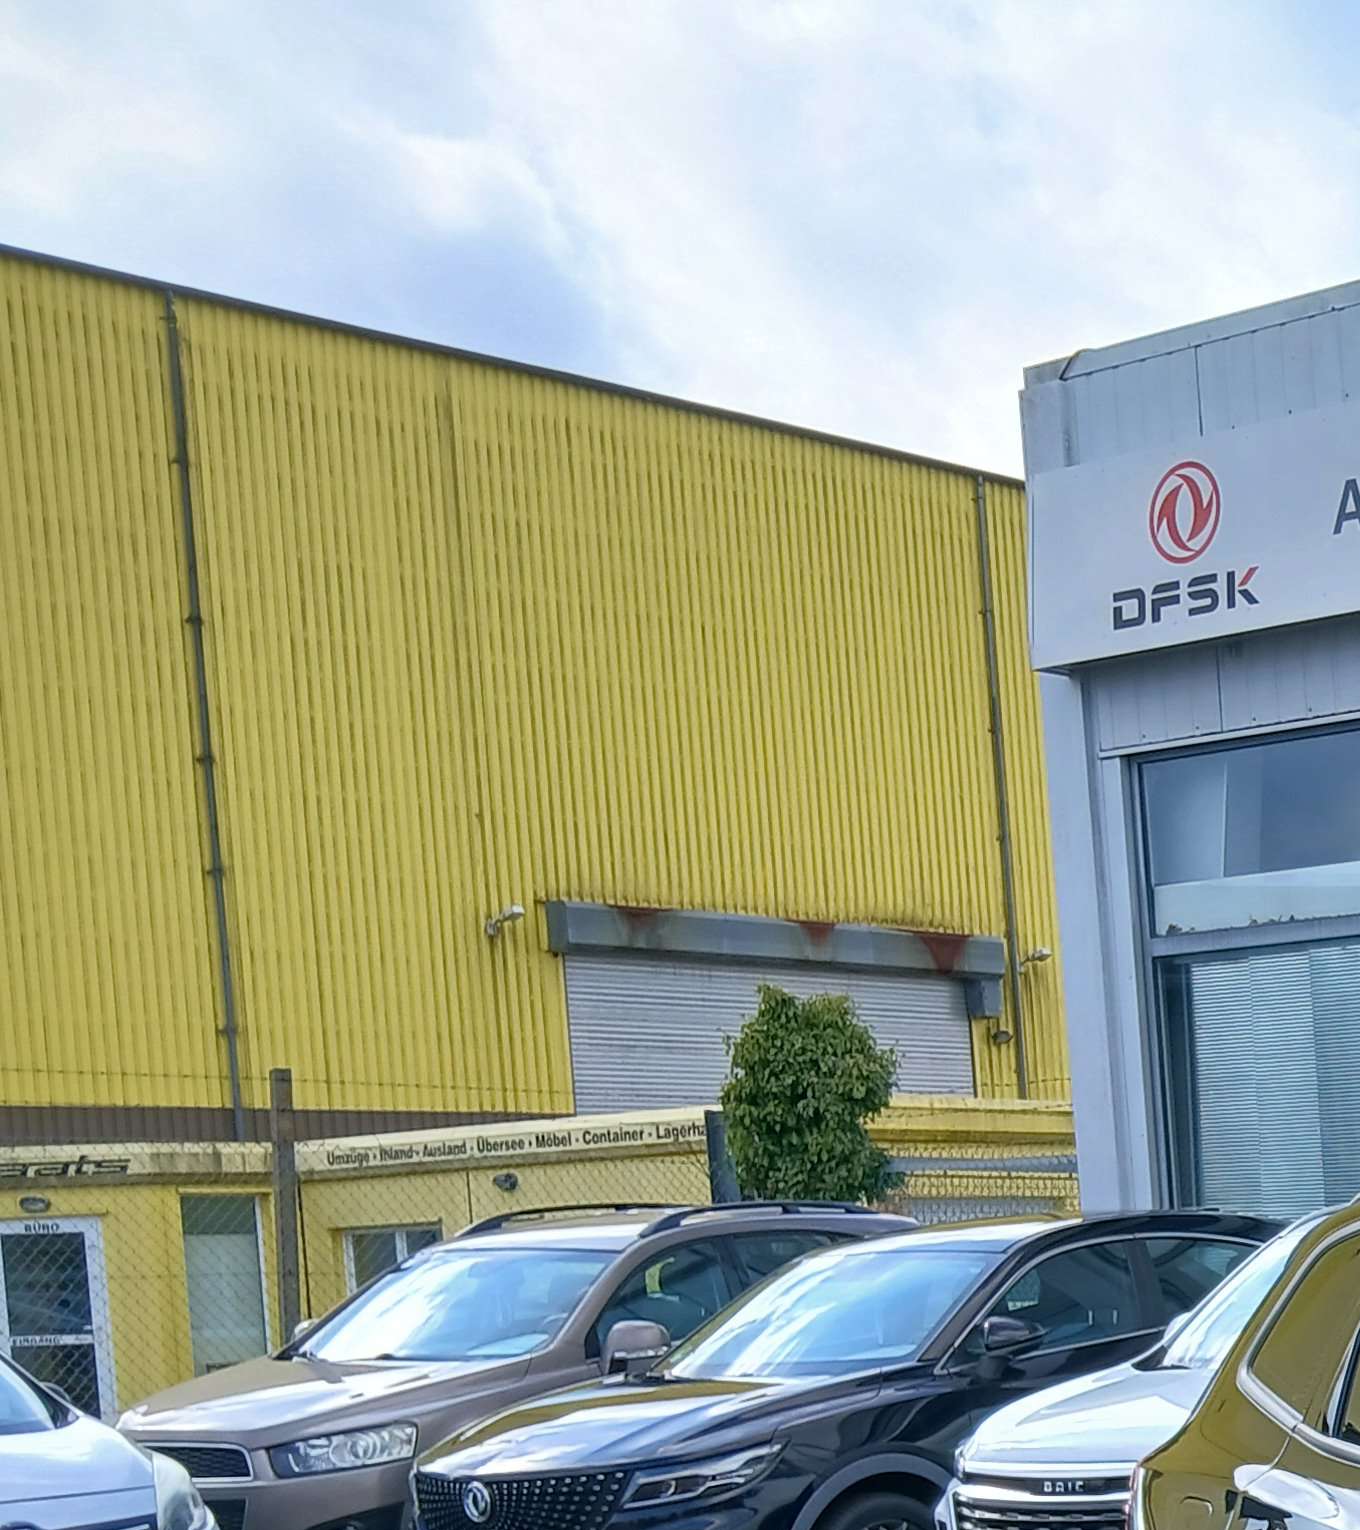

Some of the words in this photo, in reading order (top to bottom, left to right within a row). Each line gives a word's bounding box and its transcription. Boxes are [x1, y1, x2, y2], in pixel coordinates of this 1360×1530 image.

[1112, 565, 1260, 630] DFSK
[423, 1141, 467, 1157] Ausland
[476, 1136, 525, 1153] Übersee
[535, 1132, 571, 1148] Möbel
[582, 1126, 644, 1146] Container
